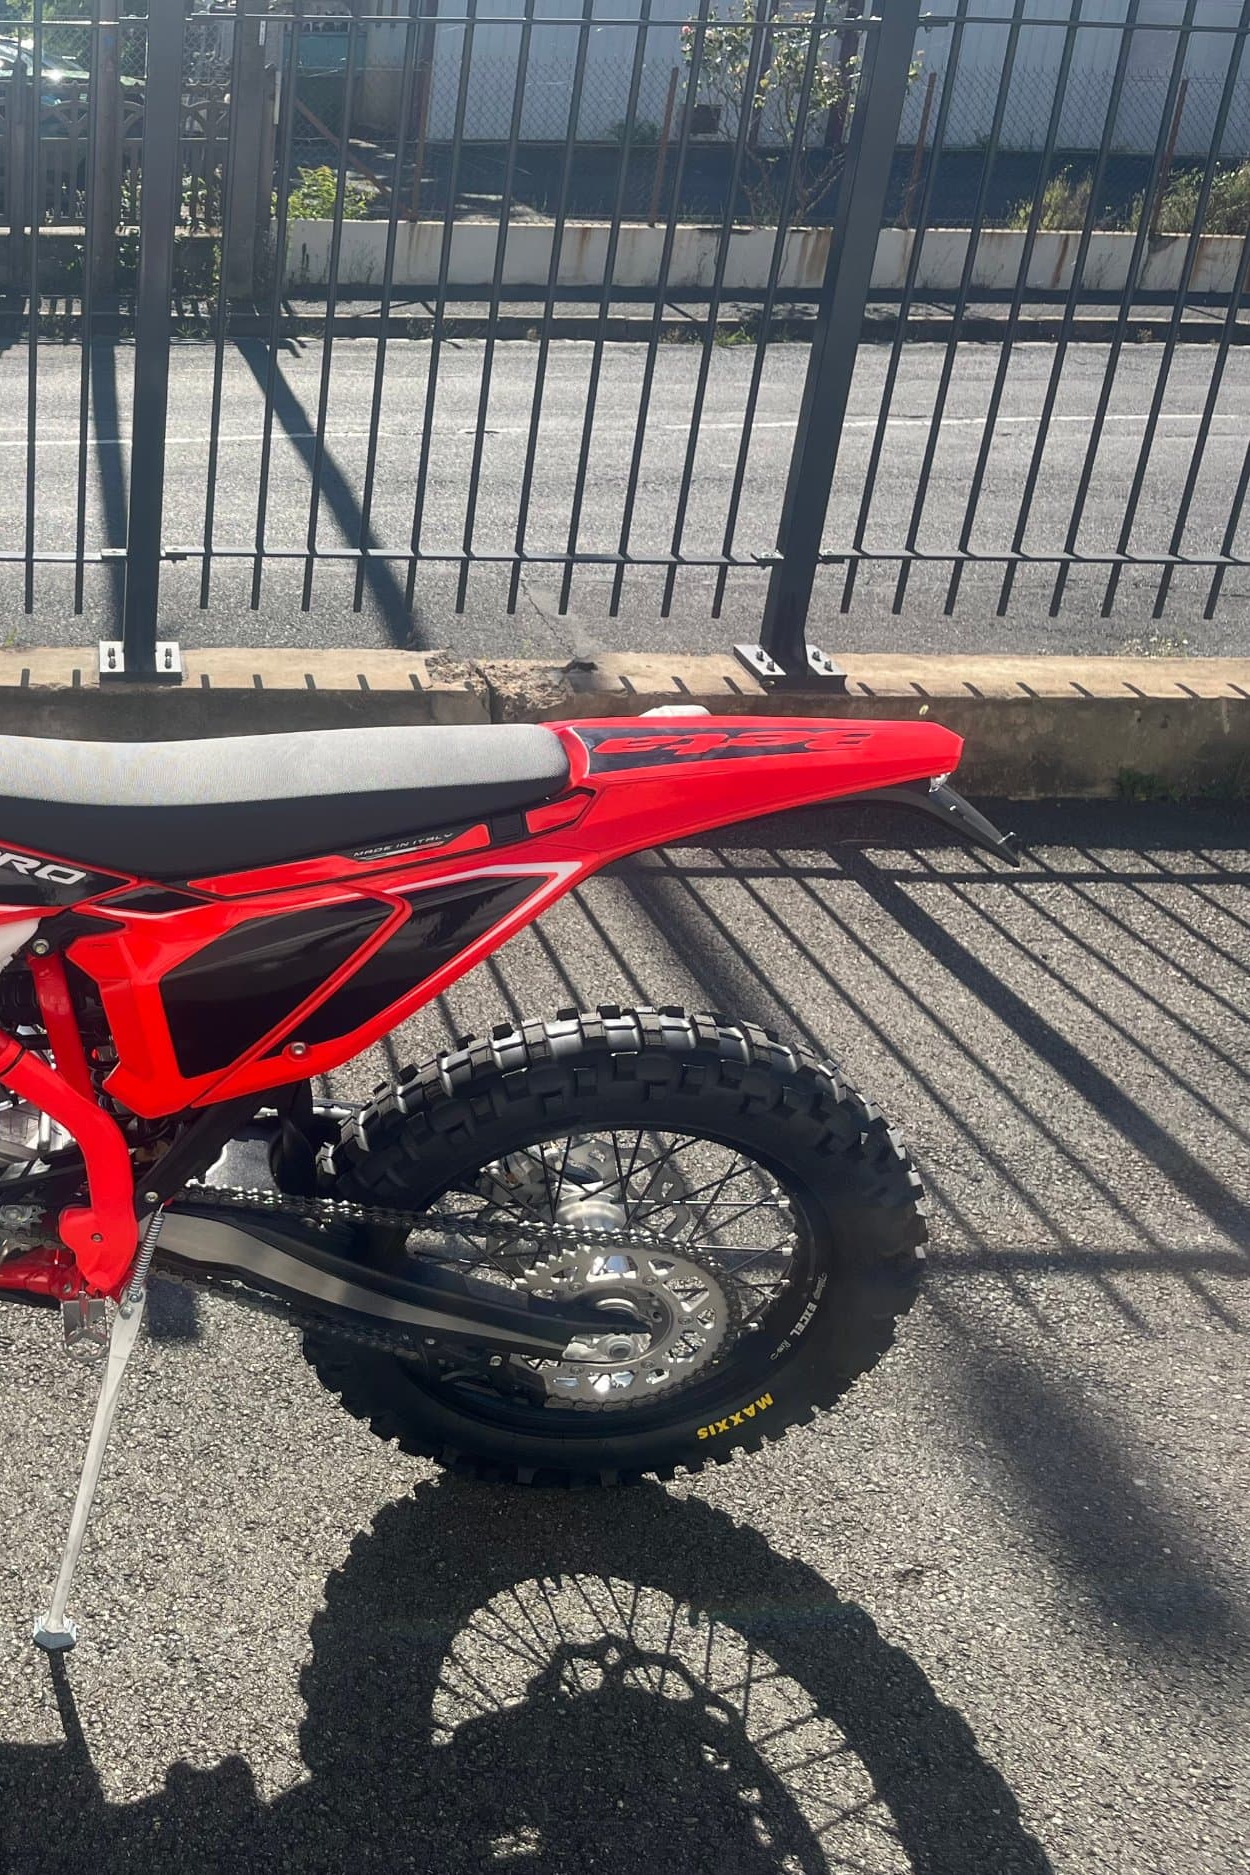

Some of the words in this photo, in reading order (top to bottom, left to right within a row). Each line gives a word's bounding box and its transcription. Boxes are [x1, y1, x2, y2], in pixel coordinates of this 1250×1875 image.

[353, 844, 394, 857] MADE
[396, 840, 410, 849] IN
[412, 832, 454, 846] ITALY
[790, 1302, 818, 1337] EXCEL
[696, 1392, 775, 1440] MAXXIS
